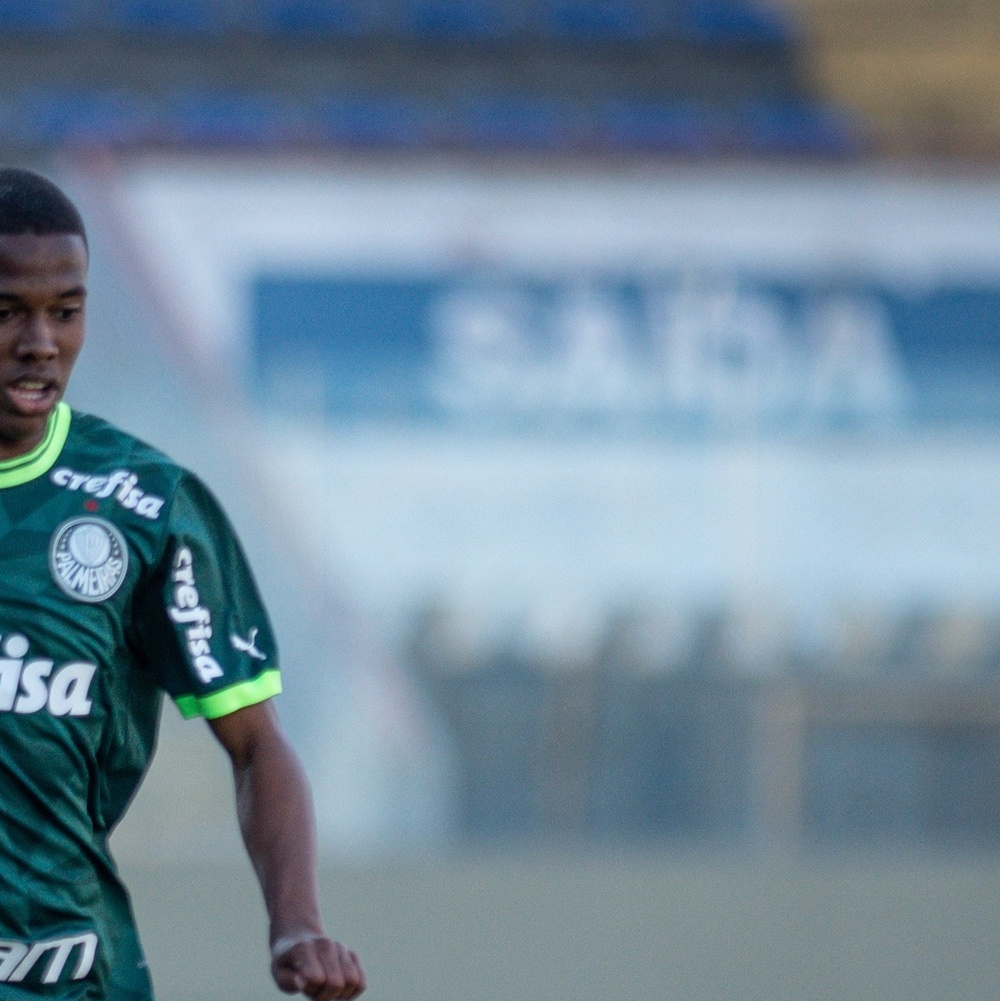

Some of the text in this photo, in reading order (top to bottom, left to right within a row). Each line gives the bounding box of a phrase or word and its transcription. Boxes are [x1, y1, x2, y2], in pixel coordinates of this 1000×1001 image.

[51, 469, 165, 519] crefisa
[56, 551, 122, 596] PALMEIRAS
[170, 546, 224, 684] crefisa
